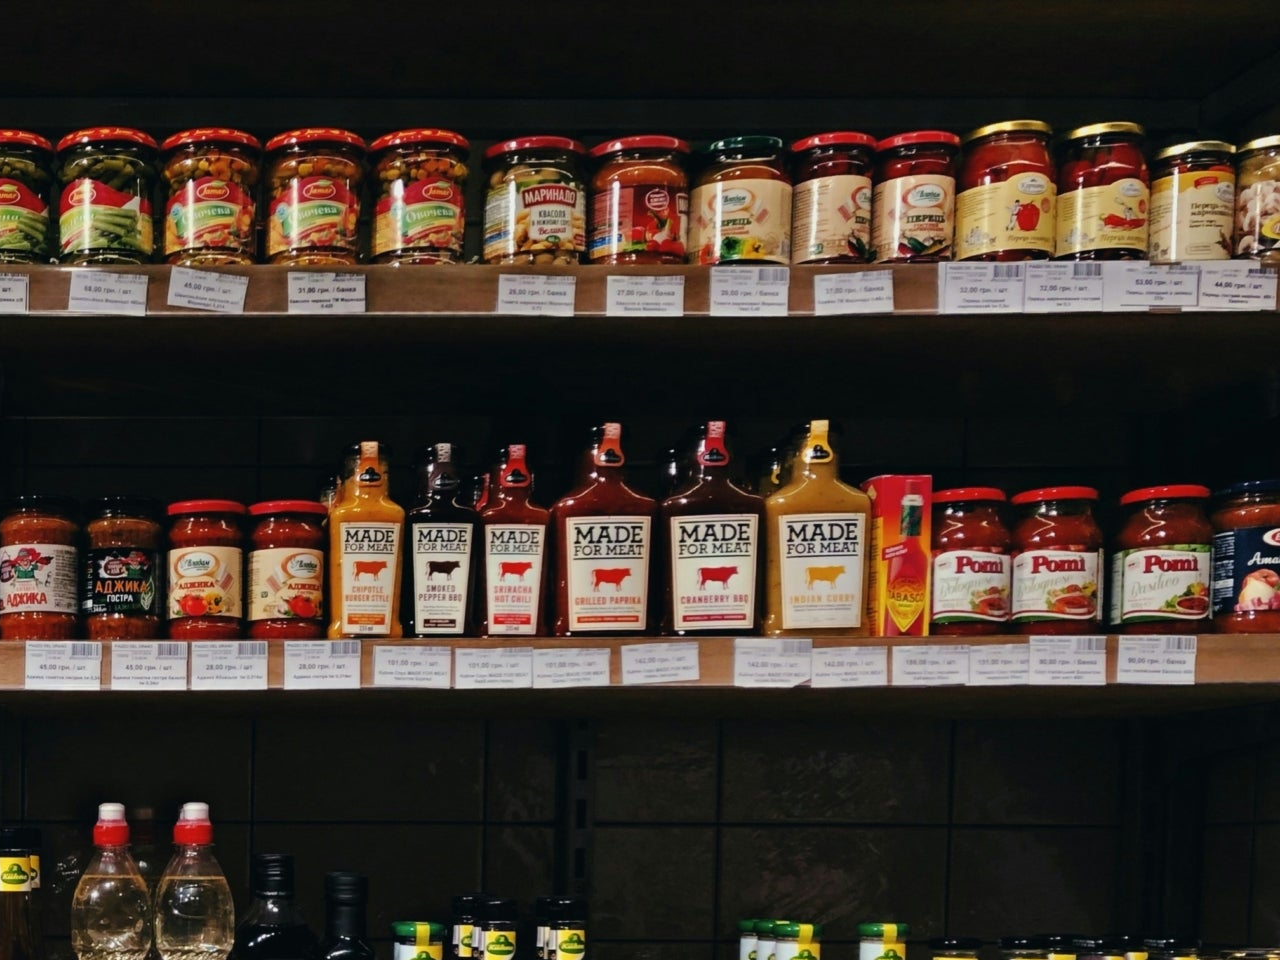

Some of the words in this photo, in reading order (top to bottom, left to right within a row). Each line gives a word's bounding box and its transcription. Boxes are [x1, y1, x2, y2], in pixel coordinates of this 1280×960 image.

[524, 188, 576, 205] МАРИНАДО
[345, 529, 394, 543] MADE
[417, 530, 467, 543] MADE
[490, 531, 539, 544] MADE
[573, 526, 643, 544] MADE
[678, 523, 751, 543] MADE
[786, 523, 859, 542] MADE
[344, 543, 364, 552] FOR
[367, 543, 395, 552] MEAT
[417, 543, 436, 552] FOR
[439, 543, 467, 552] MEAT
[490, 544, 509, 553] FOR
[512, 544, 540, 553] MEAT
[573, 545, 602, 556] FOR
[605, 545, 644, 556] MEAT
[678, 544, 709, 556] FOR
[712, 543, 751, 555] MEAT
[786, 543, 816, 555] FOR
[819, 542, 859, 554] MEAT
[95, 578, 148, 594] АДЖИКА
[426, 585, 456, 594] SMOKED
[494, 586, 533, 595] SRIRACHA
[6, 593, 47, 606] АДЖИКА
[106, 594, 134, 603] ГОСТРА
[418, 594, 447, 603] PEPPER
[575, 597, 606, 606] GRILLED
[609, 597, 642, 606] PAPRIKA
[680, 596, 730, 605] CRANBERRY
